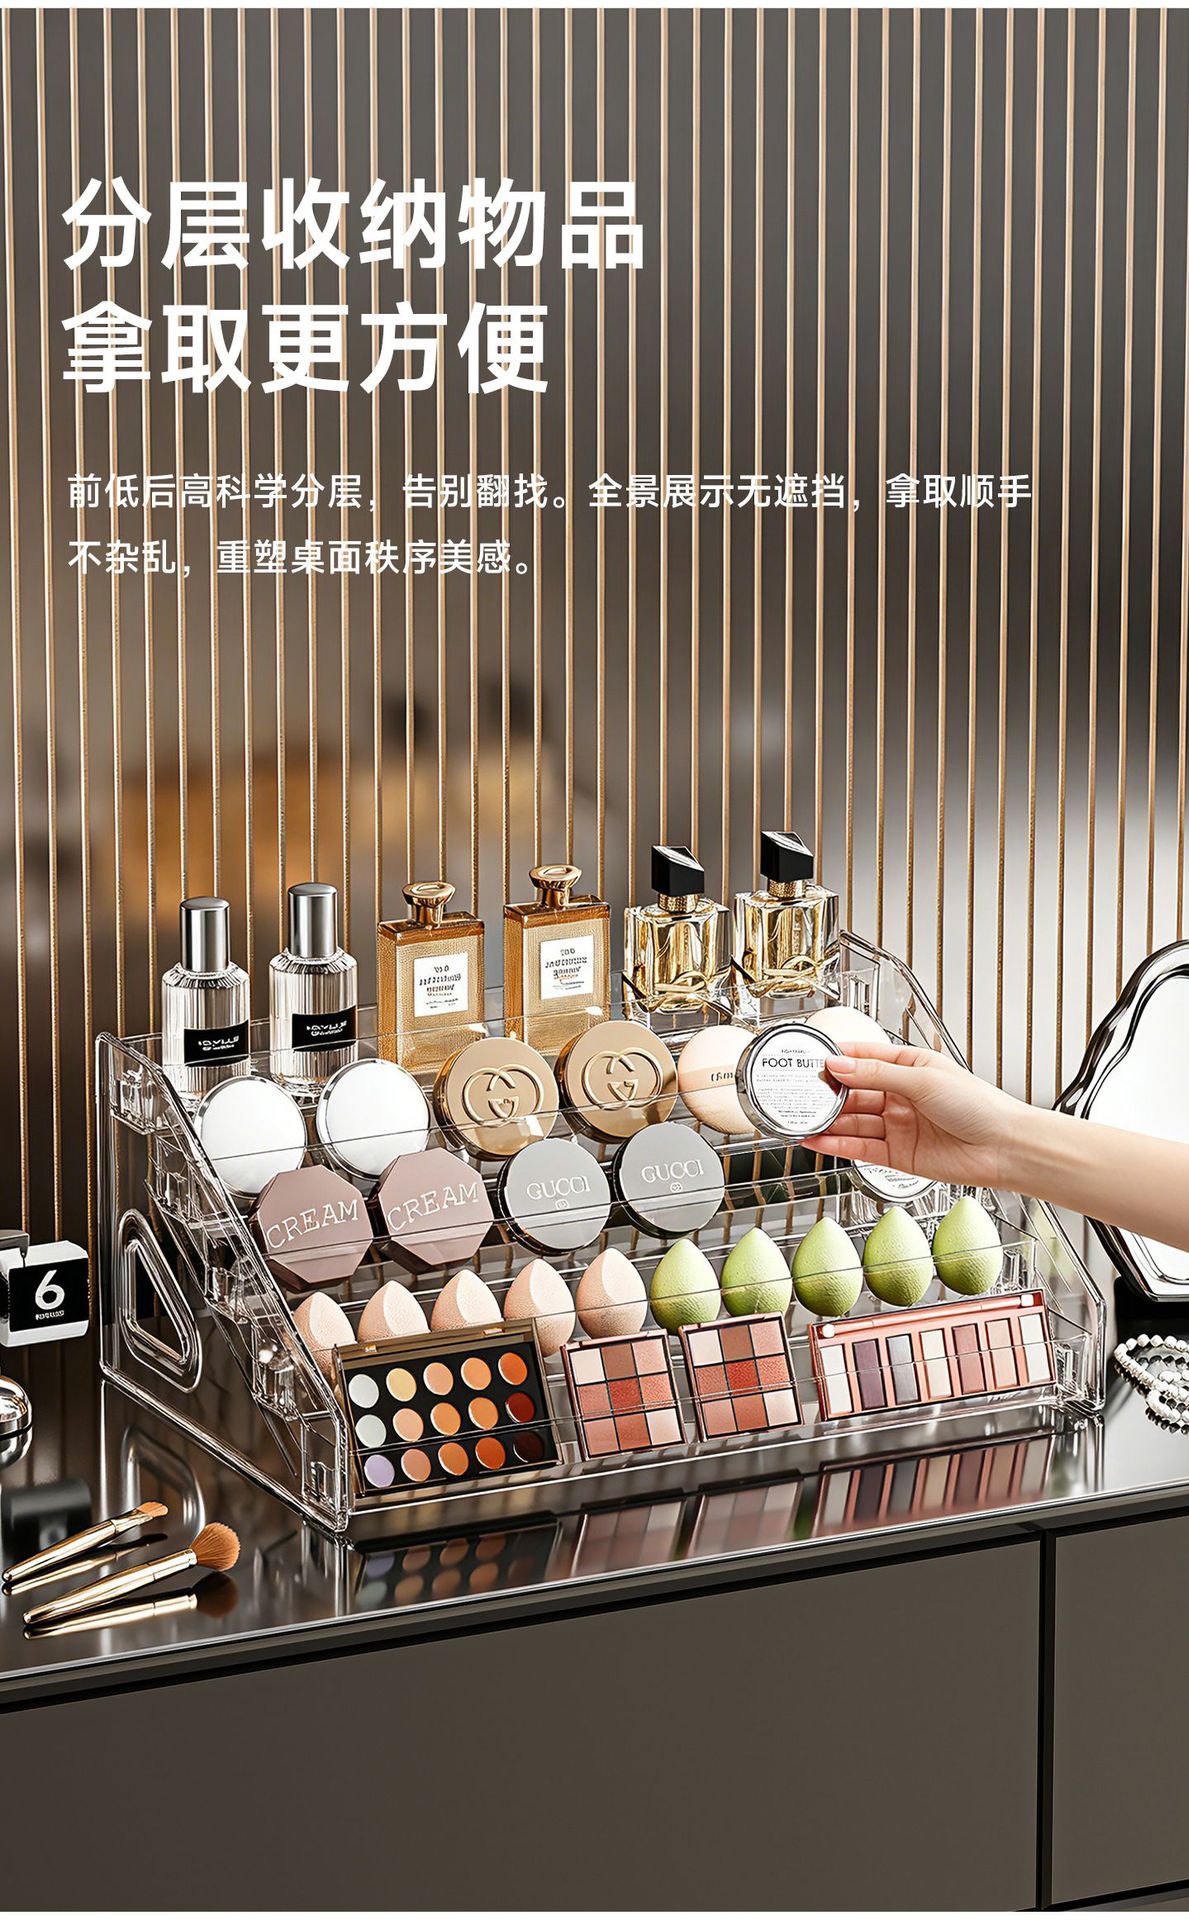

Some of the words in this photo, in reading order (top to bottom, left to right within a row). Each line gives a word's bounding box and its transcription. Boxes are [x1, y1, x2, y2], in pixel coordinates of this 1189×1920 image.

[761, 1057, 793, 1068] FOOT
[796, 1057, 825, 1069] BUTTE
[641, 1159, 705, 1184] GUCCI
[265, 1198, 359, 1250] CREAM
[388, 1181, 479, 1233] CREAM
[35, 1269, 65, 1310] 6
